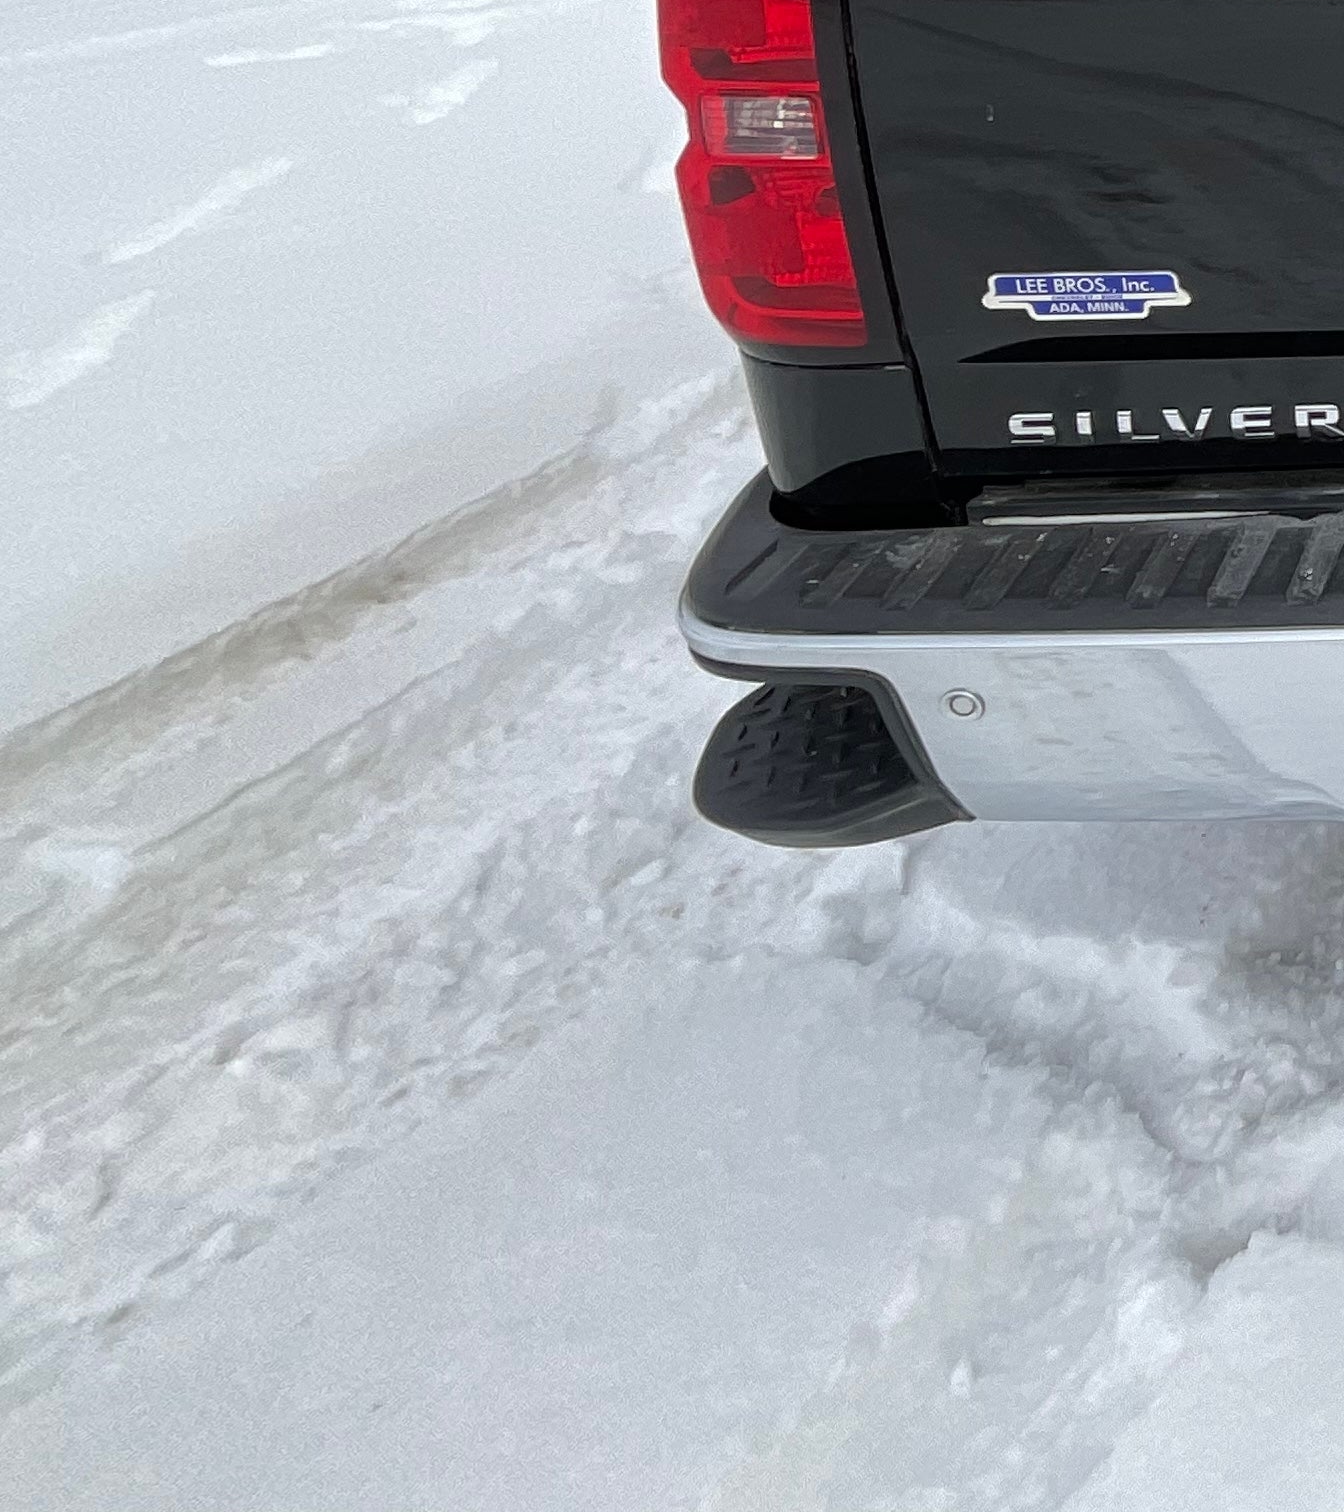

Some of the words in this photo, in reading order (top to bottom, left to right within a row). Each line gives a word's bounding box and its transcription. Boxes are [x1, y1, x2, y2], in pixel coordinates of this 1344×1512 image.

[1016, 278, 1049, 294] LEE
[1122, 276, 1155, 292] Inc.
[1087, 301, 1130, 312] MINN.
